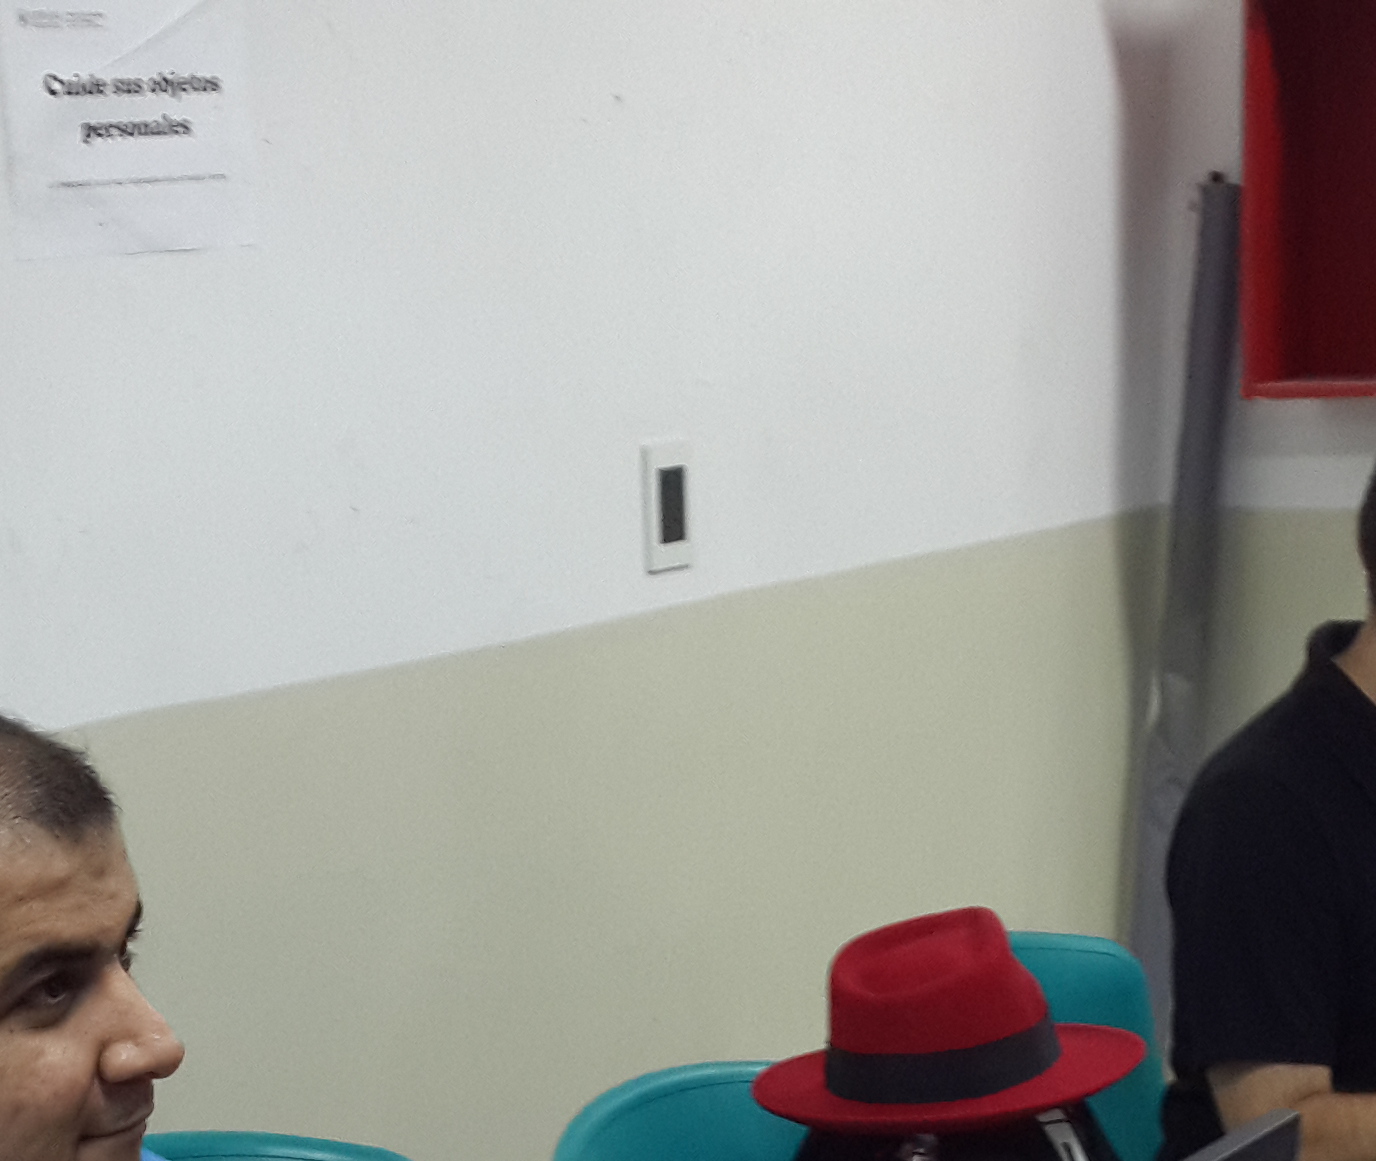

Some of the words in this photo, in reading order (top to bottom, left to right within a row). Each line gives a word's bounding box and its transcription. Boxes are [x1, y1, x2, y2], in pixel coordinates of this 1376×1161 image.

[42, 72, 109, 97] Cuide
[111, 76, 146, 95] sus
[147, 70, 223, 101] objetos
[80, 113, 193, 145] personales
